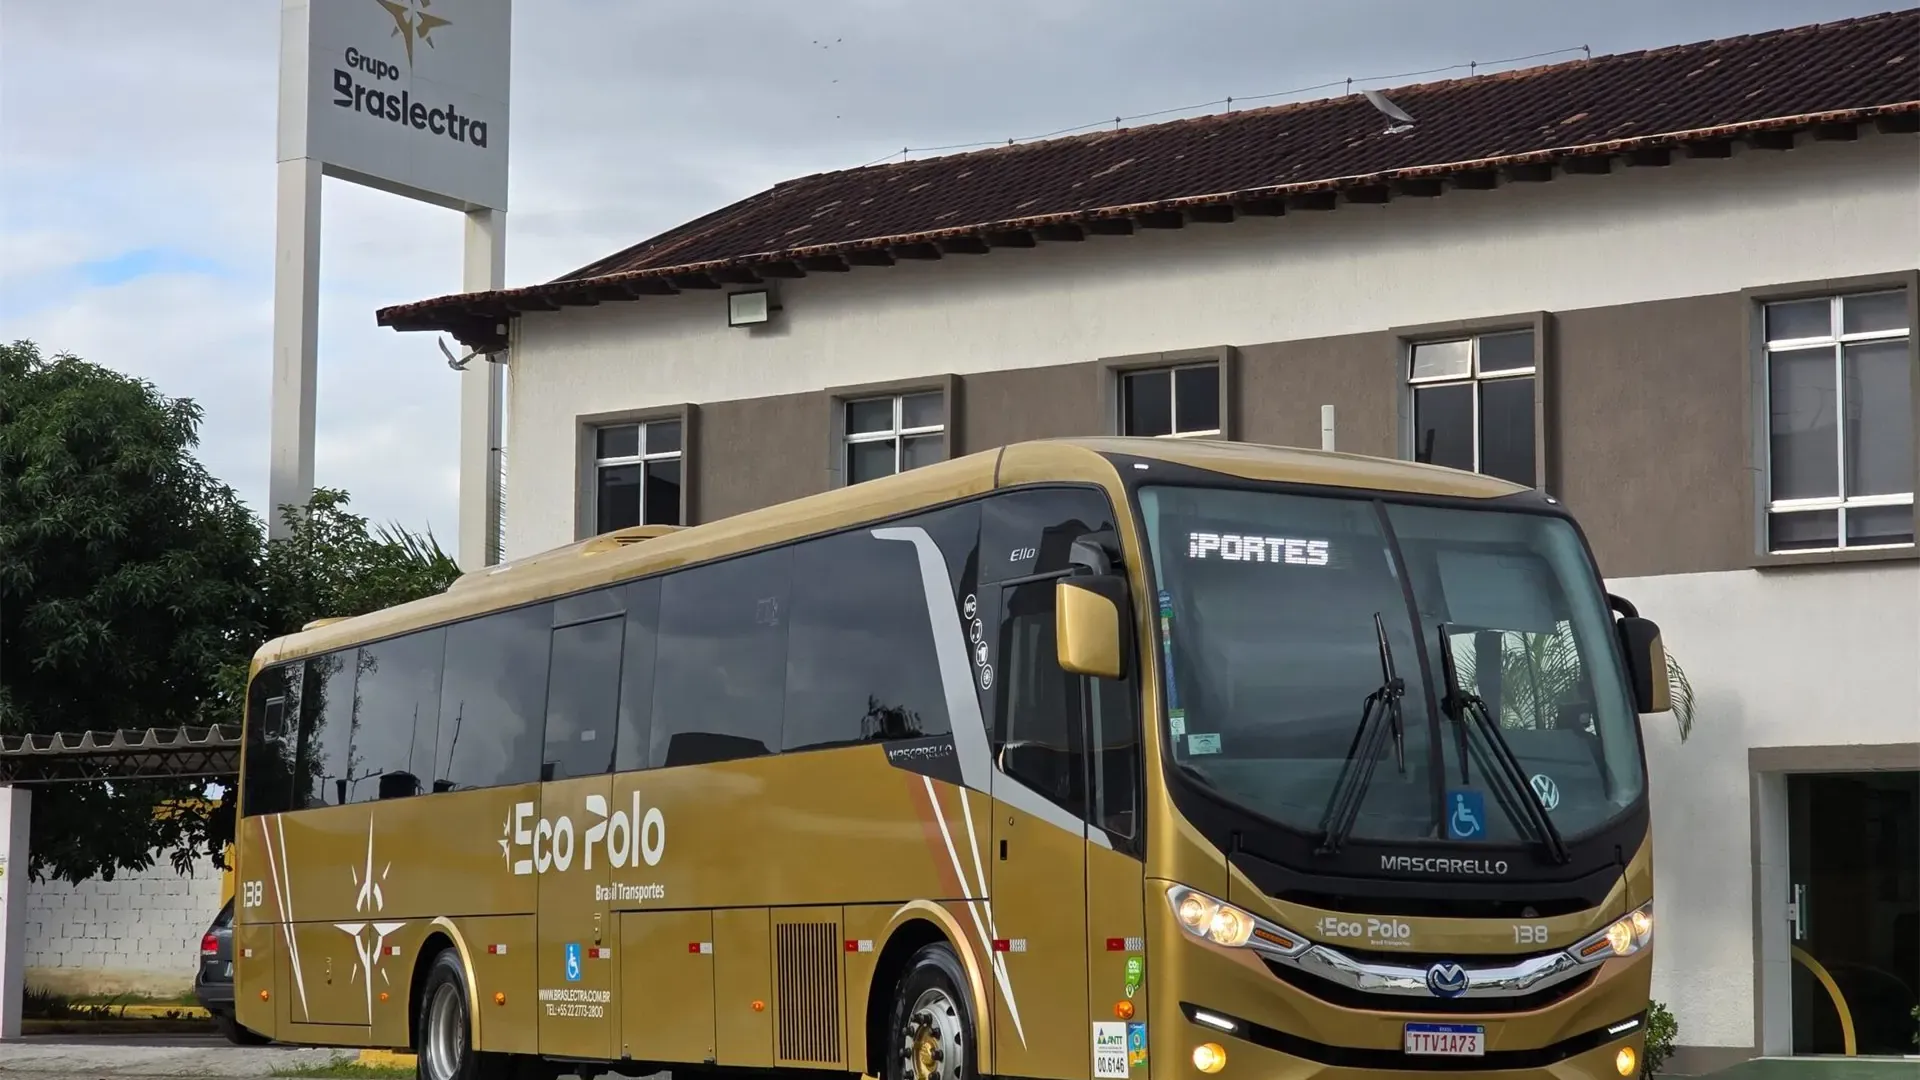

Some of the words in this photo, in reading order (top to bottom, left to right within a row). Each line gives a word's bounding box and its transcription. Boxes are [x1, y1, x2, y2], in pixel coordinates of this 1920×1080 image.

[345, 46, 399, 81] Grupo
[333, 68, 487, 148] Braslectra
[1010, 547, 1036, 562] Ello
[514, 801, 575, 875] Eco
[584, 790, 665, 870] Polo
[1381, 855, 1508, 875] MASCARELLO
[243, 881, 262, 908] 138
[595, 883, 617, 900] Brasil
[618, 883, 665, 903] Transportes
[1325, 917, 1362, 937] Eco
[1367, 918, 1410, 938] Polo
[1513, 925, 1548, 944] 138
[538, 989, 611, 1003] WWW.BRASLECTRA.COM.BR
[1413, 1034, 1476, 1052] TTV1A73
[1098, 1056, 1124, 1073] 00.6146
